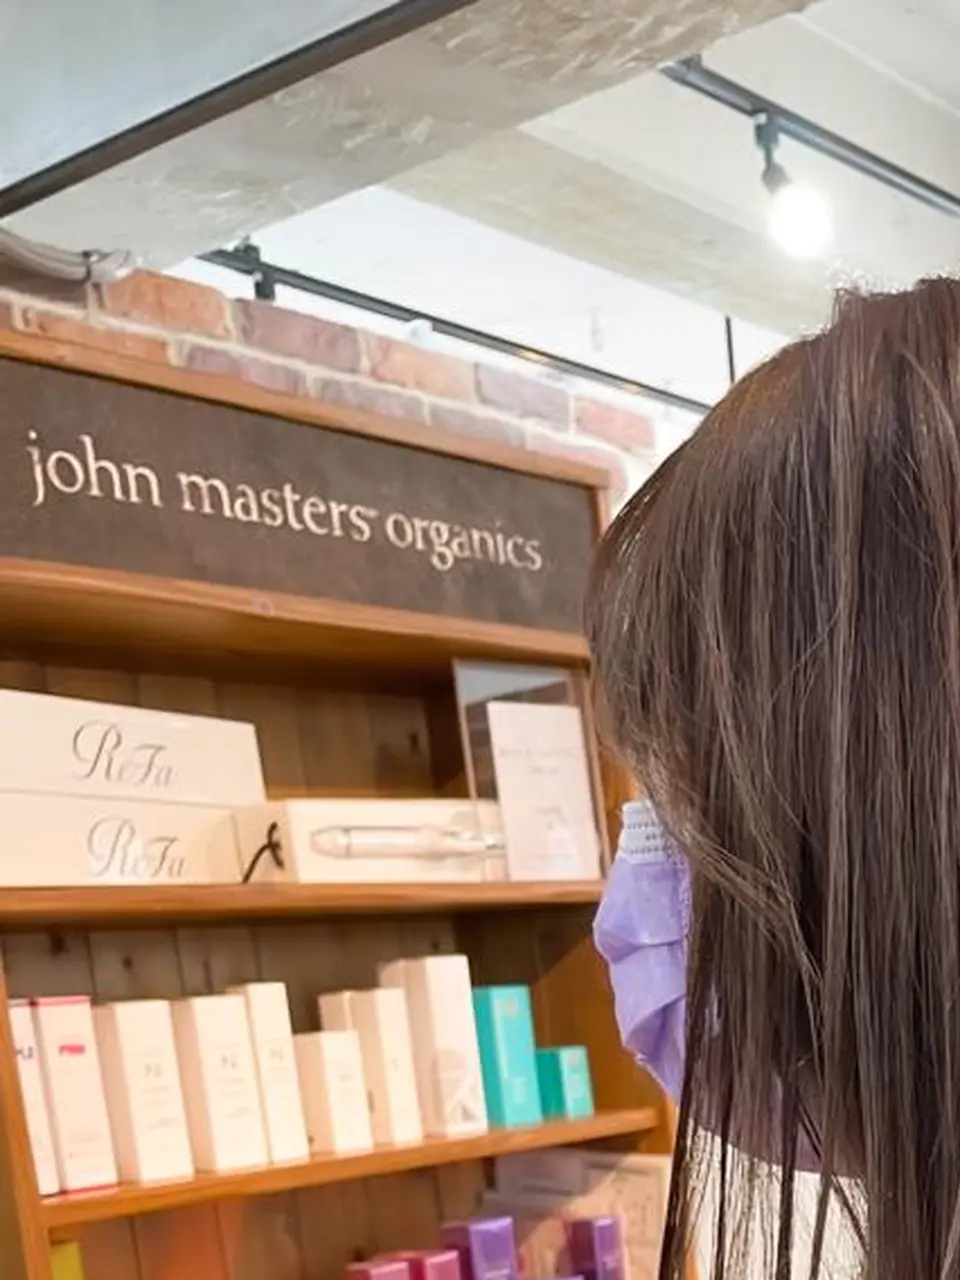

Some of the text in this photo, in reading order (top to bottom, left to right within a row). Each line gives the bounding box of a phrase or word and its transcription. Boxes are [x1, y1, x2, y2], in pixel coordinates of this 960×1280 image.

[26, 429, 542, 571] john masters organics
